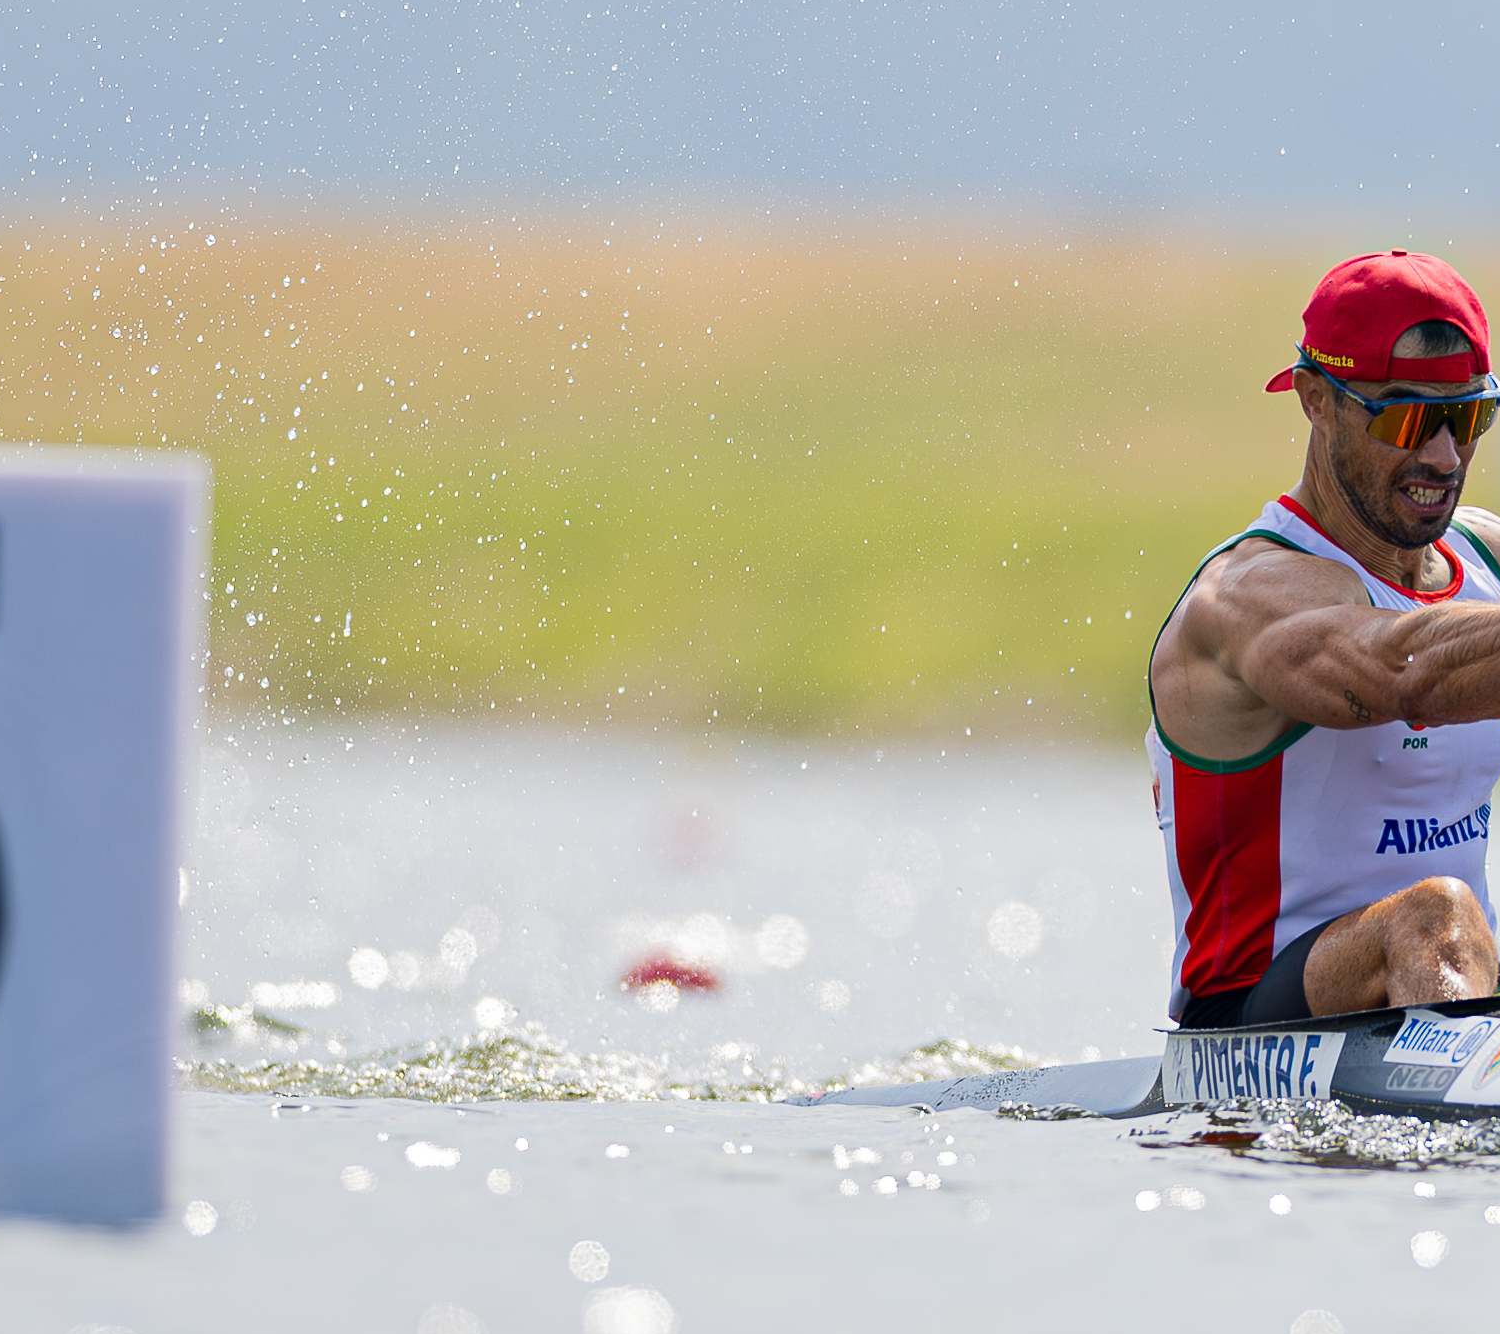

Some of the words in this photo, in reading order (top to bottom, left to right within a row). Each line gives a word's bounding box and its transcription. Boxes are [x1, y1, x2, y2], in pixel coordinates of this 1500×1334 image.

[1311, 347, 1354, 368] Pimenta
[1402, 737, 1428, 749] POR
[1375, 814, 1479, 854] Allianz
[1392, 1018, 1461, 1054] Allianz
[1191, 1034, 1295, 1100] PIMENTA
[1388, 1066, 1455, 1088] NELO
